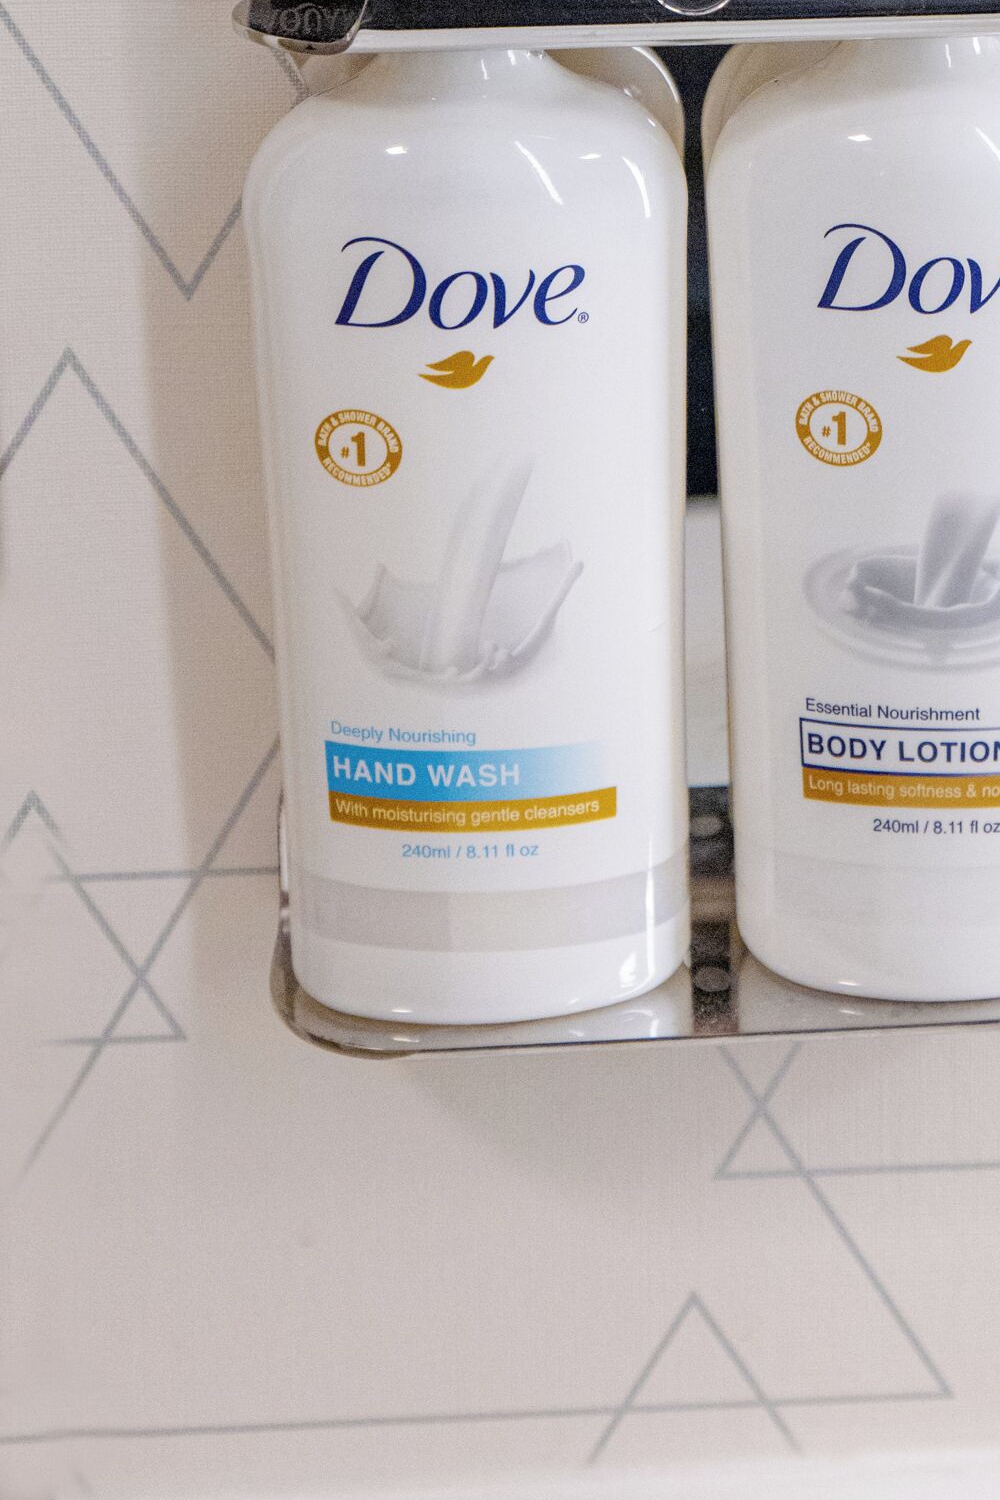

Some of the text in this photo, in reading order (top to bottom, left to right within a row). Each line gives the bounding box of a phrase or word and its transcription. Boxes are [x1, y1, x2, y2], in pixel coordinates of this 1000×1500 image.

[820, 391, 858, 406] SHOWER
[338, 411, 377, 425] SHOWER
[822, 411, 847, 446] #1
[341, 431, 366, 467] #1
[805, 697, 981, 721] Essential Nourishment
[330, 721, 476, 746] Deeply Nourishing
[807, 733, 887, 761] BODY
[332, 755, 520, 787] HAND WASH
[808, 775, 843, 796] Long
[847, 778, 895, 800] lasting
[899, 781, 962, 798] softness
[966, 784, 977, 798] &
[334, 799, 599, 827] With moisturising gentle cleansers
[873, 818, 919, 834] 240ml
[933, 820, 964, 834] 8.11
[970, 820, 979, 833] fl
[983, 822, 1000, 833] oz
[402, 844, 450, 859] 240ml
[466, 844, 499, 859] 8.11
[505, 843, 515, 857] fl
[520, 846, 539, 857] oz
